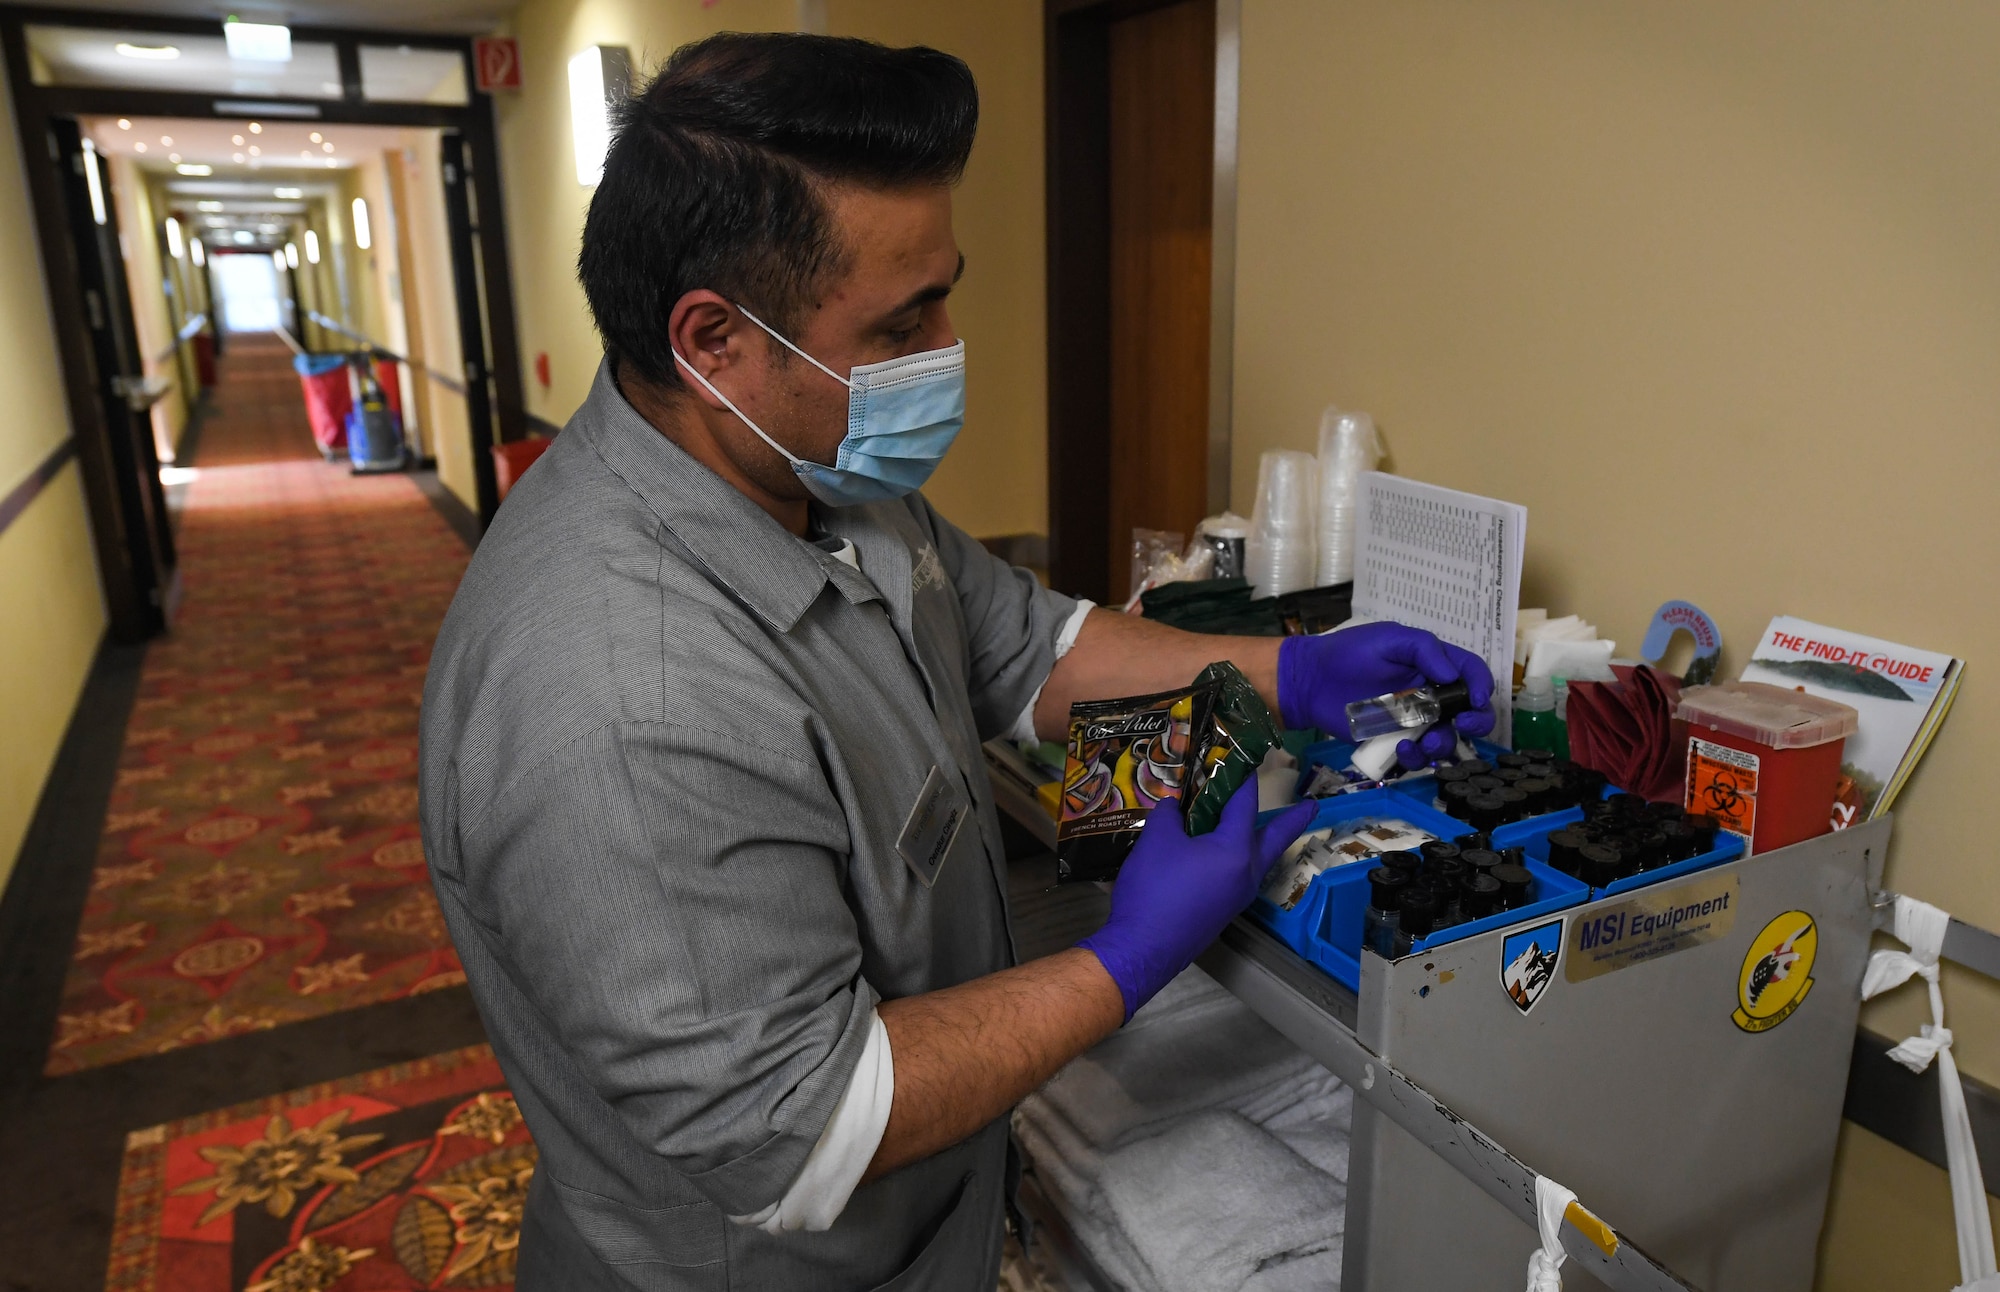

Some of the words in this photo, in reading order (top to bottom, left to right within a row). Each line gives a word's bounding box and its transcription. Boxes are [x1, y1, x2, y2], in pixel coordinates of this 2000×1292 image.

[1496, 518, 1504, 586] Housekeeping
[1495, 588, 1503, 631] Checkoff
[1662, 607, 1695, 621] PLEASE
[1695, 614, 1714, 648] REUSE
[1772, 632, 1805, 652] THE
[1804, 640, 1869, 667] FIND-IT
[1871, 656, 1933, 683] GUIDE
[1070, 823, 1097, 833] FRENCH
[1098, 820, 1121, 828] ROAST
[1098, 812, 1131, 823] GOURMET
[1580, 911, 1626, 951] MSI
[1630, 891, 1730, 936] Equipment
